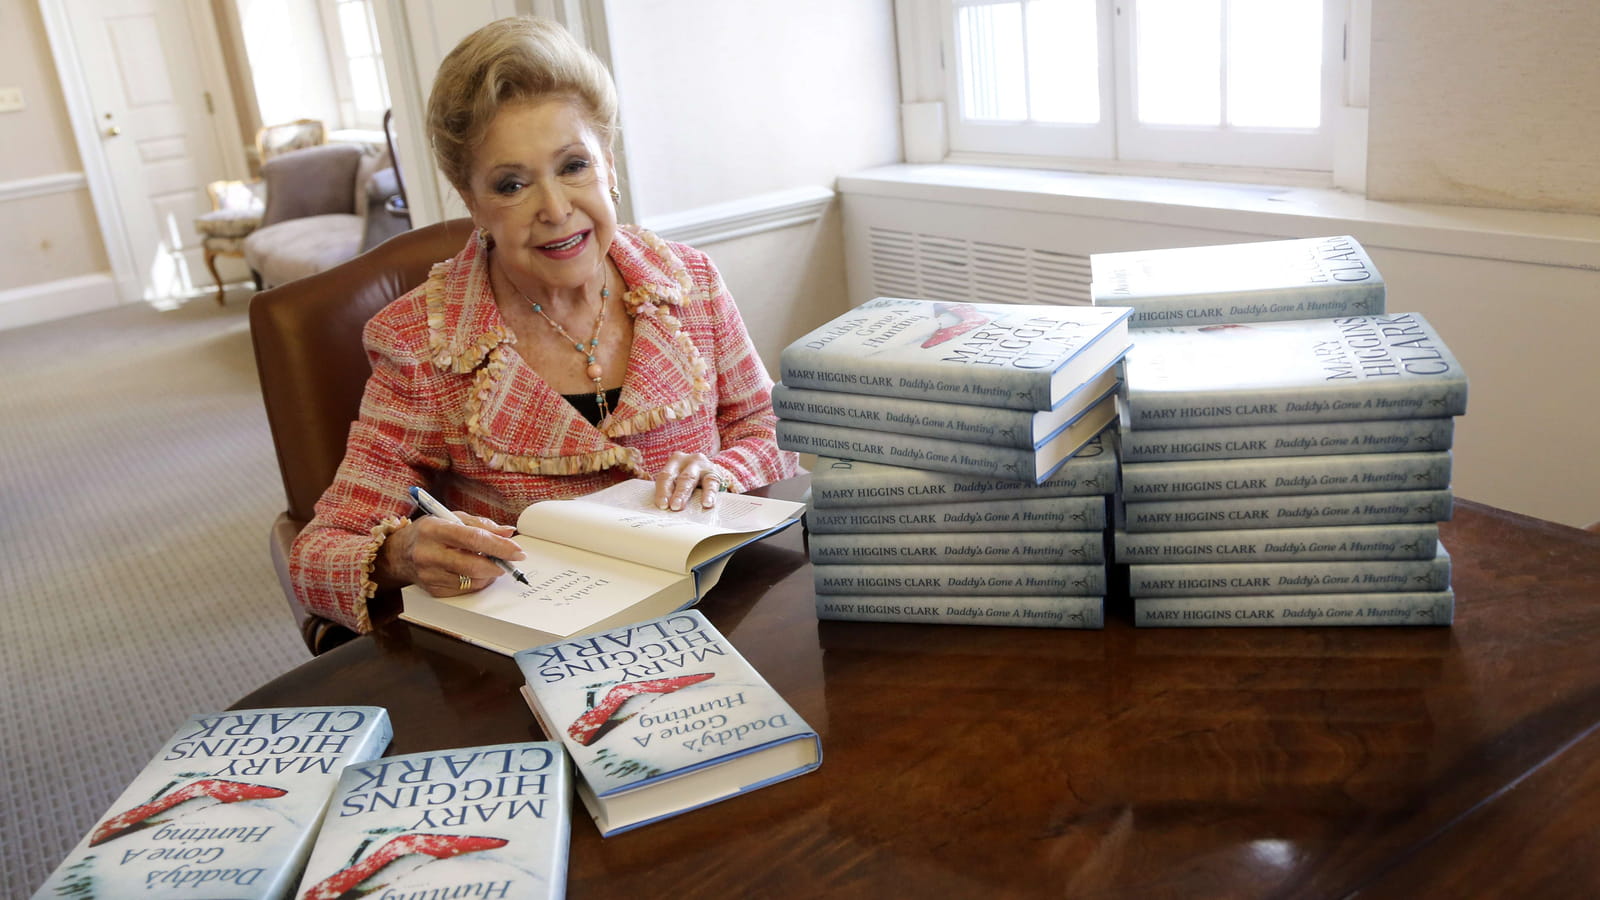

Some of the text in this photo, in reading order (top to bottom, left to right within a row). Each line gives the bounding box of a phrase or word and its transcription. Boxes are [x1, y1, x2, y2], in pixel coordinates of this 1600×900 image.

[1139, 309, 1183, 321] HIGGINS
[1187, 308, 1222, 318] CLARK
[1230, 303, 1268, 316] Daddy's
[1270, 303, 1294, 312] Gone
[1296, 303, 1304, 311] A
[1307, 301, 1347, 311] Hunting
[941, 319, 1013, 364] MARY
[1333, 317, 1400, 377] HIGGINS
[1371, 313, 1449, 375] CLARK
[1312, 340, 1357, 381] MARY
[788, 369, 1011, 398] MARY HIGGINS CLARK Daddy's Gone A Hunting
[779, 401, 994, 435] MARY HIGGINS CLARK Daddy's Gone A Hunting
[1141, 397, 1423, 419] MARY HIGGINS CLARK Daddy's Gone A Hunting
[784, 434, 998, 472] MARY HIGGINS CLARK Daddy's Gone A Hunting
[1133, 434, 1409, 454] MARY HIGGINS CLARK Daddy's Gone A Hunting
[822, 489, 855, 499] MARY
[857, 486, 904, 498] HIGGINS
[908, 484, 946, 495] CLARK
[954, 480, 993, 493] Daddy's
[995, 480, 1020, 490] Gone
[1034, 479, 1077, 488] unting
[1134, 472, 1408, 494] MARY HIGGINS CLARK Daddy's Gone A Hunting
[817, 512, 1064, 525] MARY HIGGINS CLARK Daddy's Gone A Hunting
[1137, 504, 1409, 523] MARY HIGGINS CLARK Daddy's Gone A Hunting
[819, 545, 1063, 557] MARY HIGGINS CLARK Daddy's Gone A Hunting
[1126, 541, 1395, 555] MARY HIGGINS CLARK Daddy's Gone A Hunting
[824, 577, 1066, 588] MARY HIGGINS CLARK Daddy's Gone A Hunting
[1141, 573, 1408, 589] MARY HIGGINS CLARK Daddy's Gone A Hunting
[824, 604, 1063, 621] MARY HIGGINS CLARK Daddy's Gone A Hunting
[1146, 607, 1411, 620] MARY HIGGINS CLARK Daddy's Gone A Hunting
[527, 615, 700, 668] CLARK
[539, 630, 715, 684] HIGGINS
[621, 644, 729, 682] MARY
[639, 691, 748, 728] Hunting
[181, 711, 366, 740] CLARK
[633, 714, 728, 748] Gone A
[682, 714, 790, 752] Daddy's
[164, 735, 354, 762] HIGGINS
[210, 756, 340, 777] MARY
[347, 747, 553, 793] CLARK
[340, 774, 550, 818] HIGGINS
[405, 799, 549, 830] MARY
[152, 823, 275, 845] Hunting
[119, 847, 225, 865] Gone A
[146, 864, 267, 890] Daddy's
